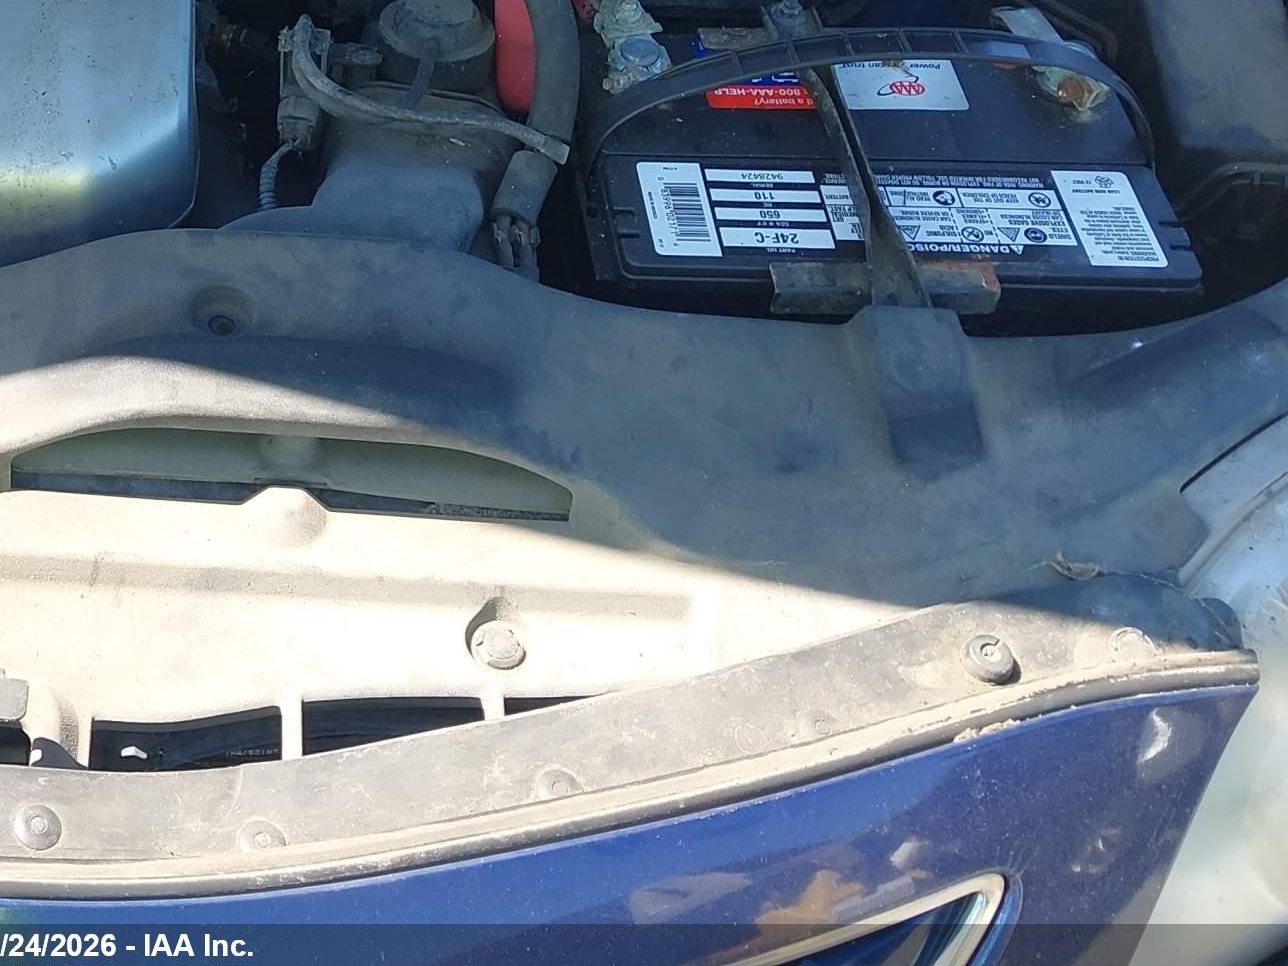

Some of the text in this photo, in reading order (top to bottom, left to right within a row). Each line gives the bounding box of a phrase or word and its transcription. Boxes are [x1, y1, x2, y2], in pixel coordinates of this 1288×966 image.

[892, 82, 921, 94] AAA
[754, 98, 796, 106] battery?
[754, 192, 775, 200] 110
[760, 210, 780, 218] 650
[754, 232, 799, 244] 24F-C
[906, 244, 1010, 254] DANGER/POISO
